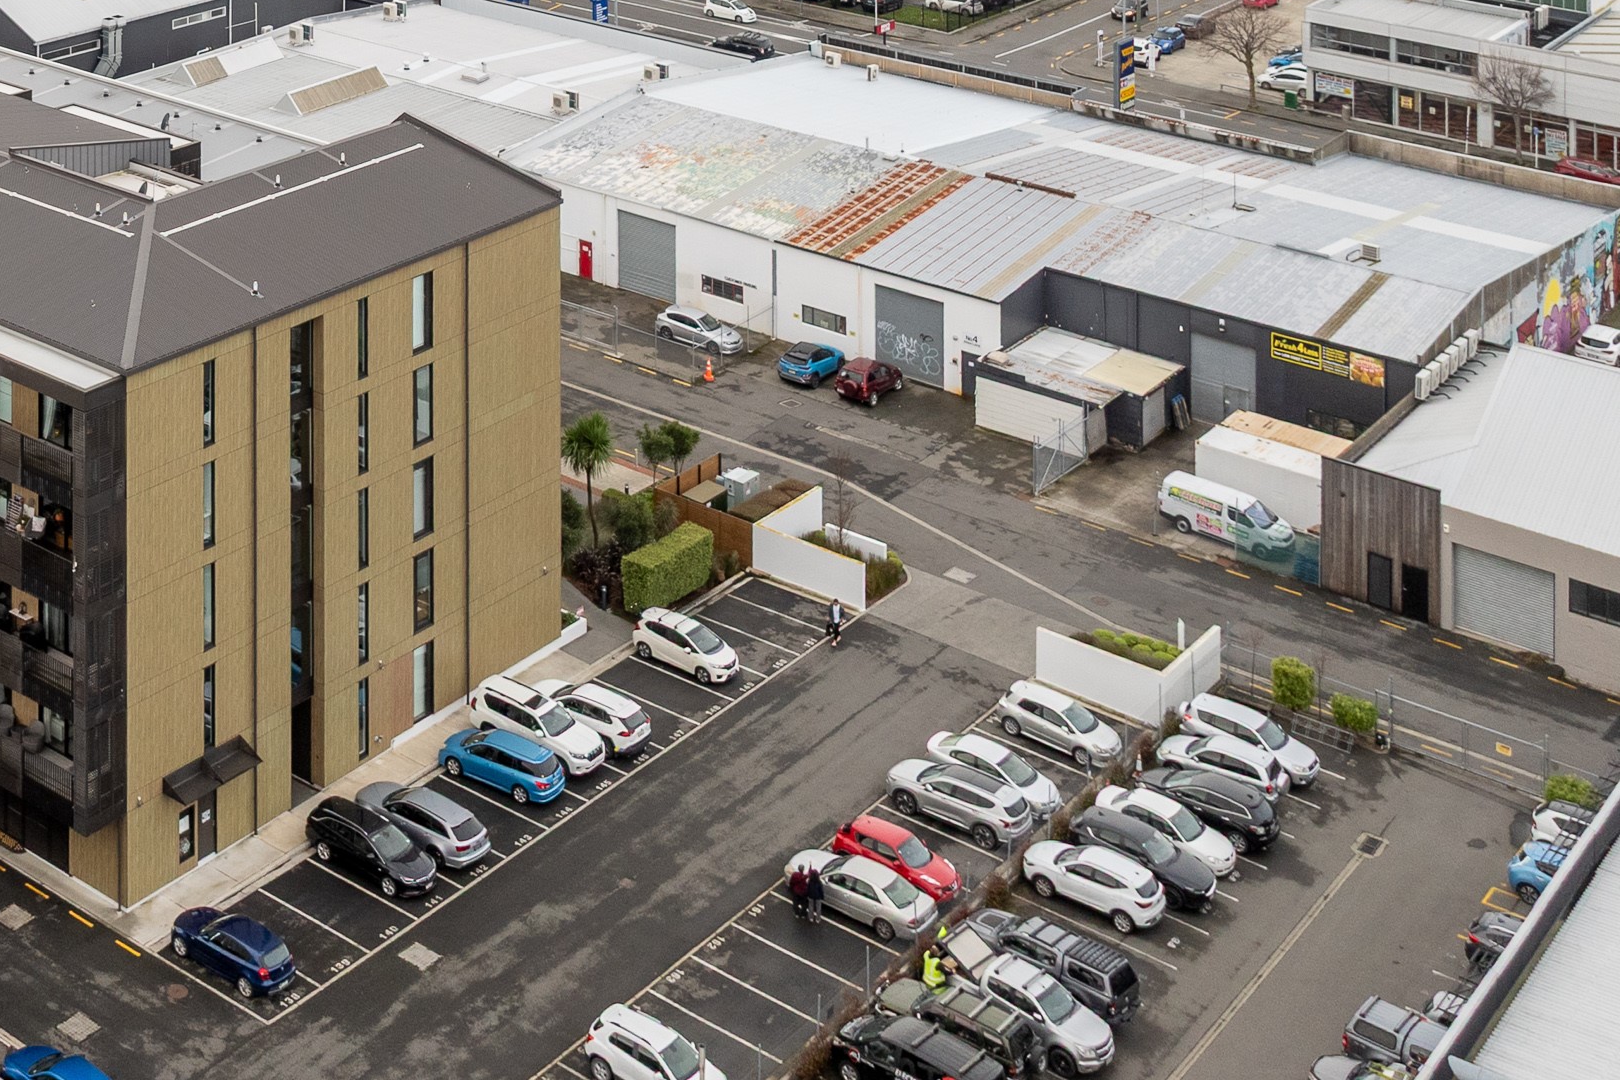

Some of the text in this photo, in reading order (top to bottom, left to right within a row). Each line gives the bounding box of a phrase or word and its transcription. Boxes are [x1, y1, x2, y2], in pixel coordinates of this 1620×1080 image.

[595, 779, 612, 792] 145
[555, 806, 574, 819] 144
[514, 834, 533, 848] 143
[469, 863, 489, 878] 142
[425, 894, 444, 909] 141
[379, 925, 399, 940] 140
[331, 958, 351, 973] 139
